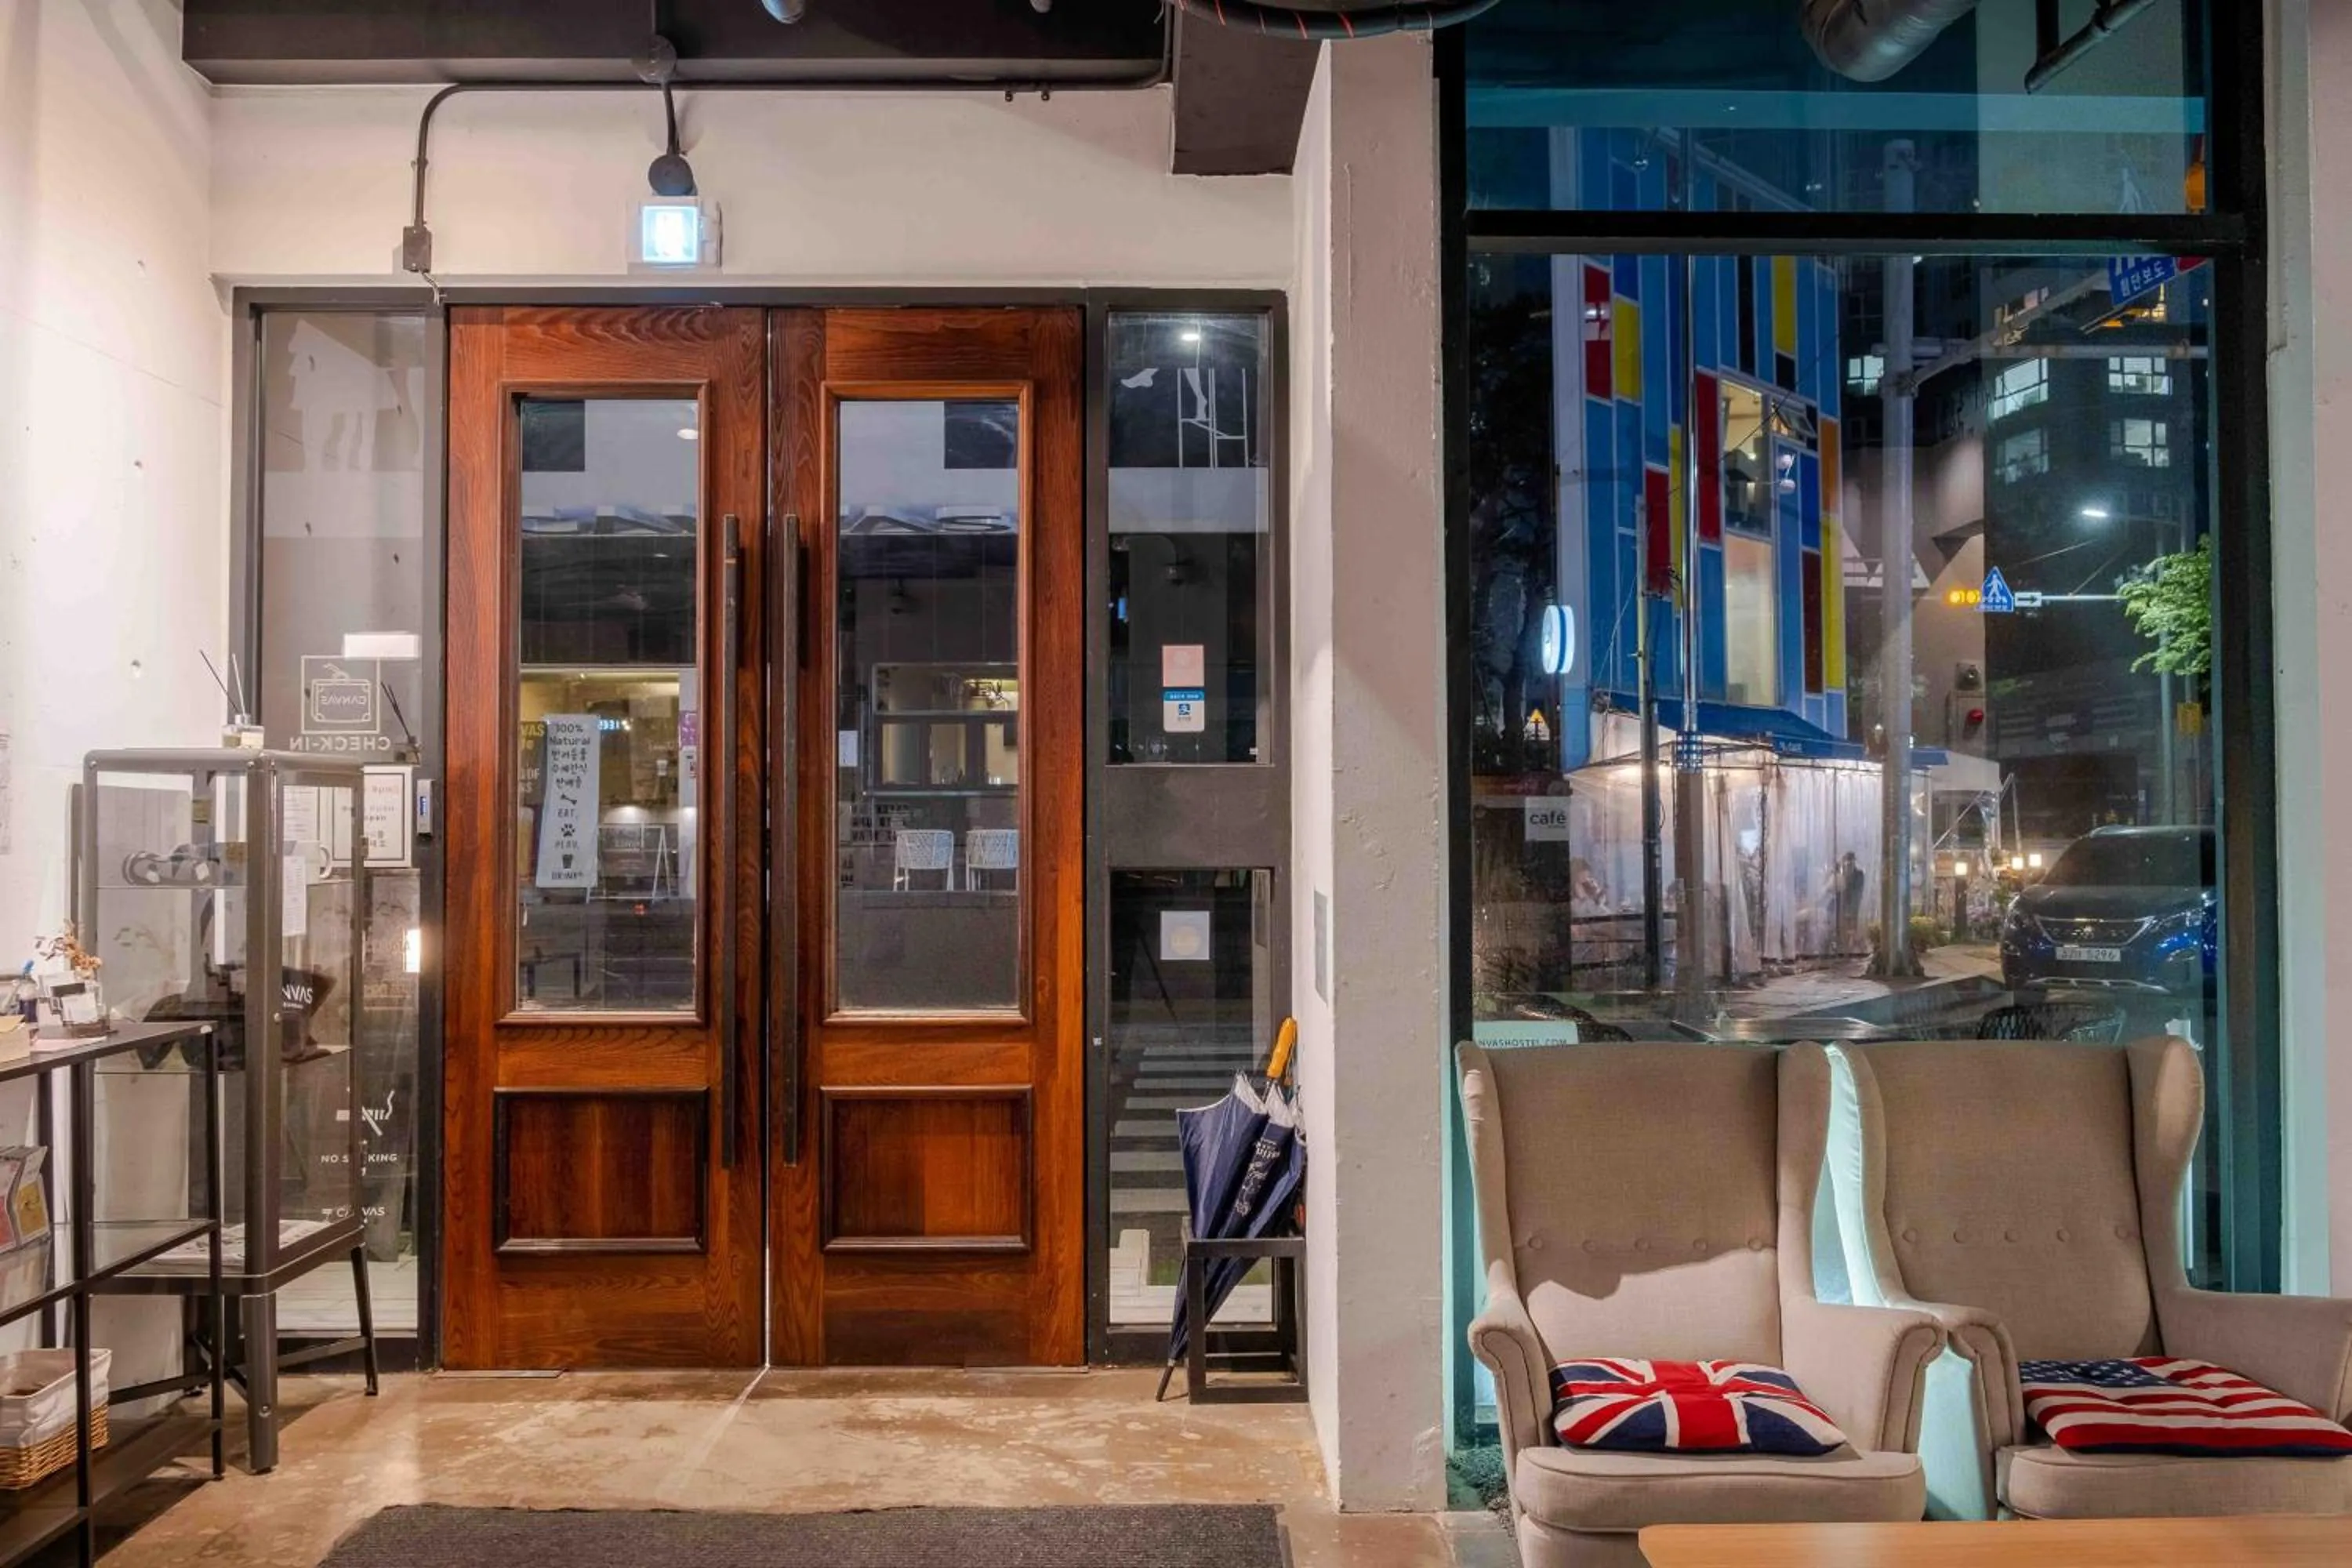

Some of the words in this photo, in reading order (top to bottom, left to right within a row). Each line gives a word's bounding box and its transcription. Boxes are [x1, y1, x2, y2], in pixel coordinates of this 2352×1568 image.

[556, 723, 583, 733] 100%
[550, 736, 590, 745] Natural
[1530, 810, 1566, 825] café
[321, 1154, 339, 1163] NO
[342, 1153, 397, 1163] SKING
